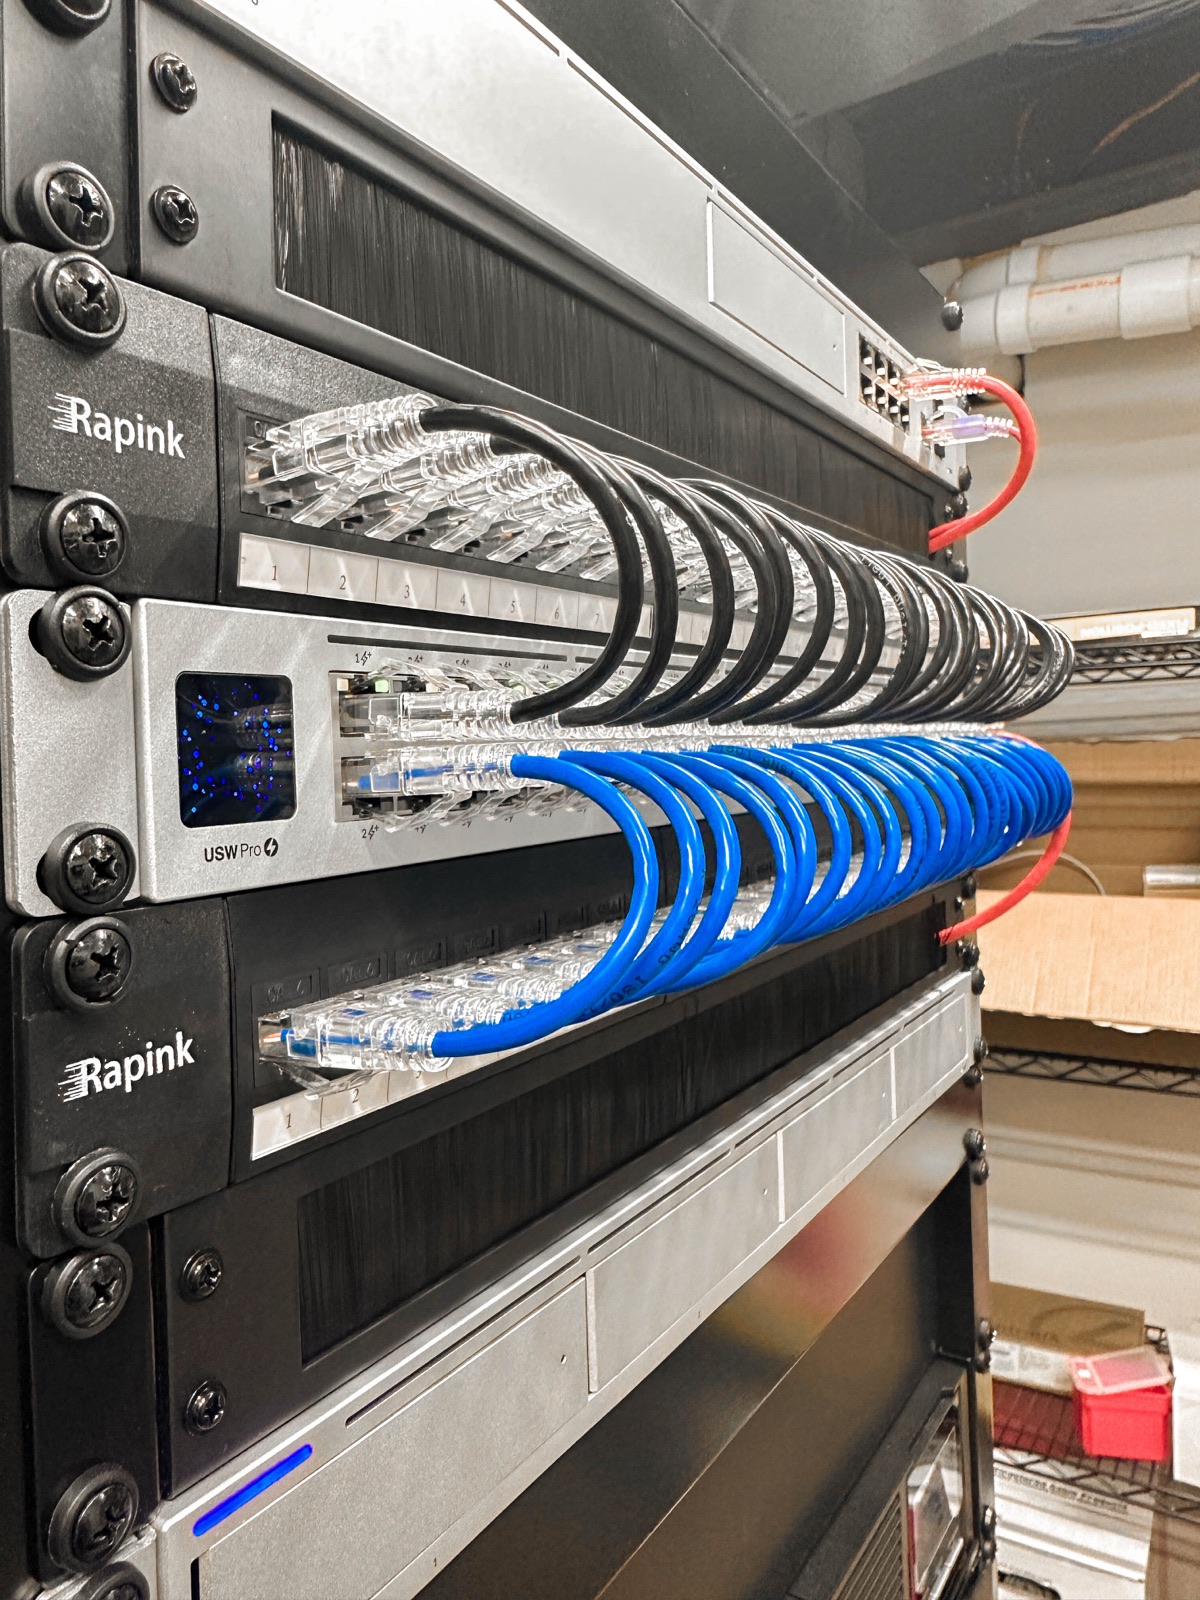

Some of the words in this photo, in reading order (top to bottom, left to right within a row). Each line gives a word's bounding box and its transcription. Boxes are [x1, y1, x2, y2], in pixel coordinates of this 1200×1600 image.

[48, 392, 186, 459] Rapink
[271, 565, 278, 581] 1
[339, 575, 347, 591] 2
[403, 584, 411, 599] 3
[459, 593, 467, 607] 4
[510, 600, 516, 614] 5
[554, 607, 560, 620] 6
[595, 613, 600, 625] 7
[57, 1030, 196, 1103] Rapink
[286, 1112, 292, 1129] 1
[352, 1088, 360, 1104] 2
